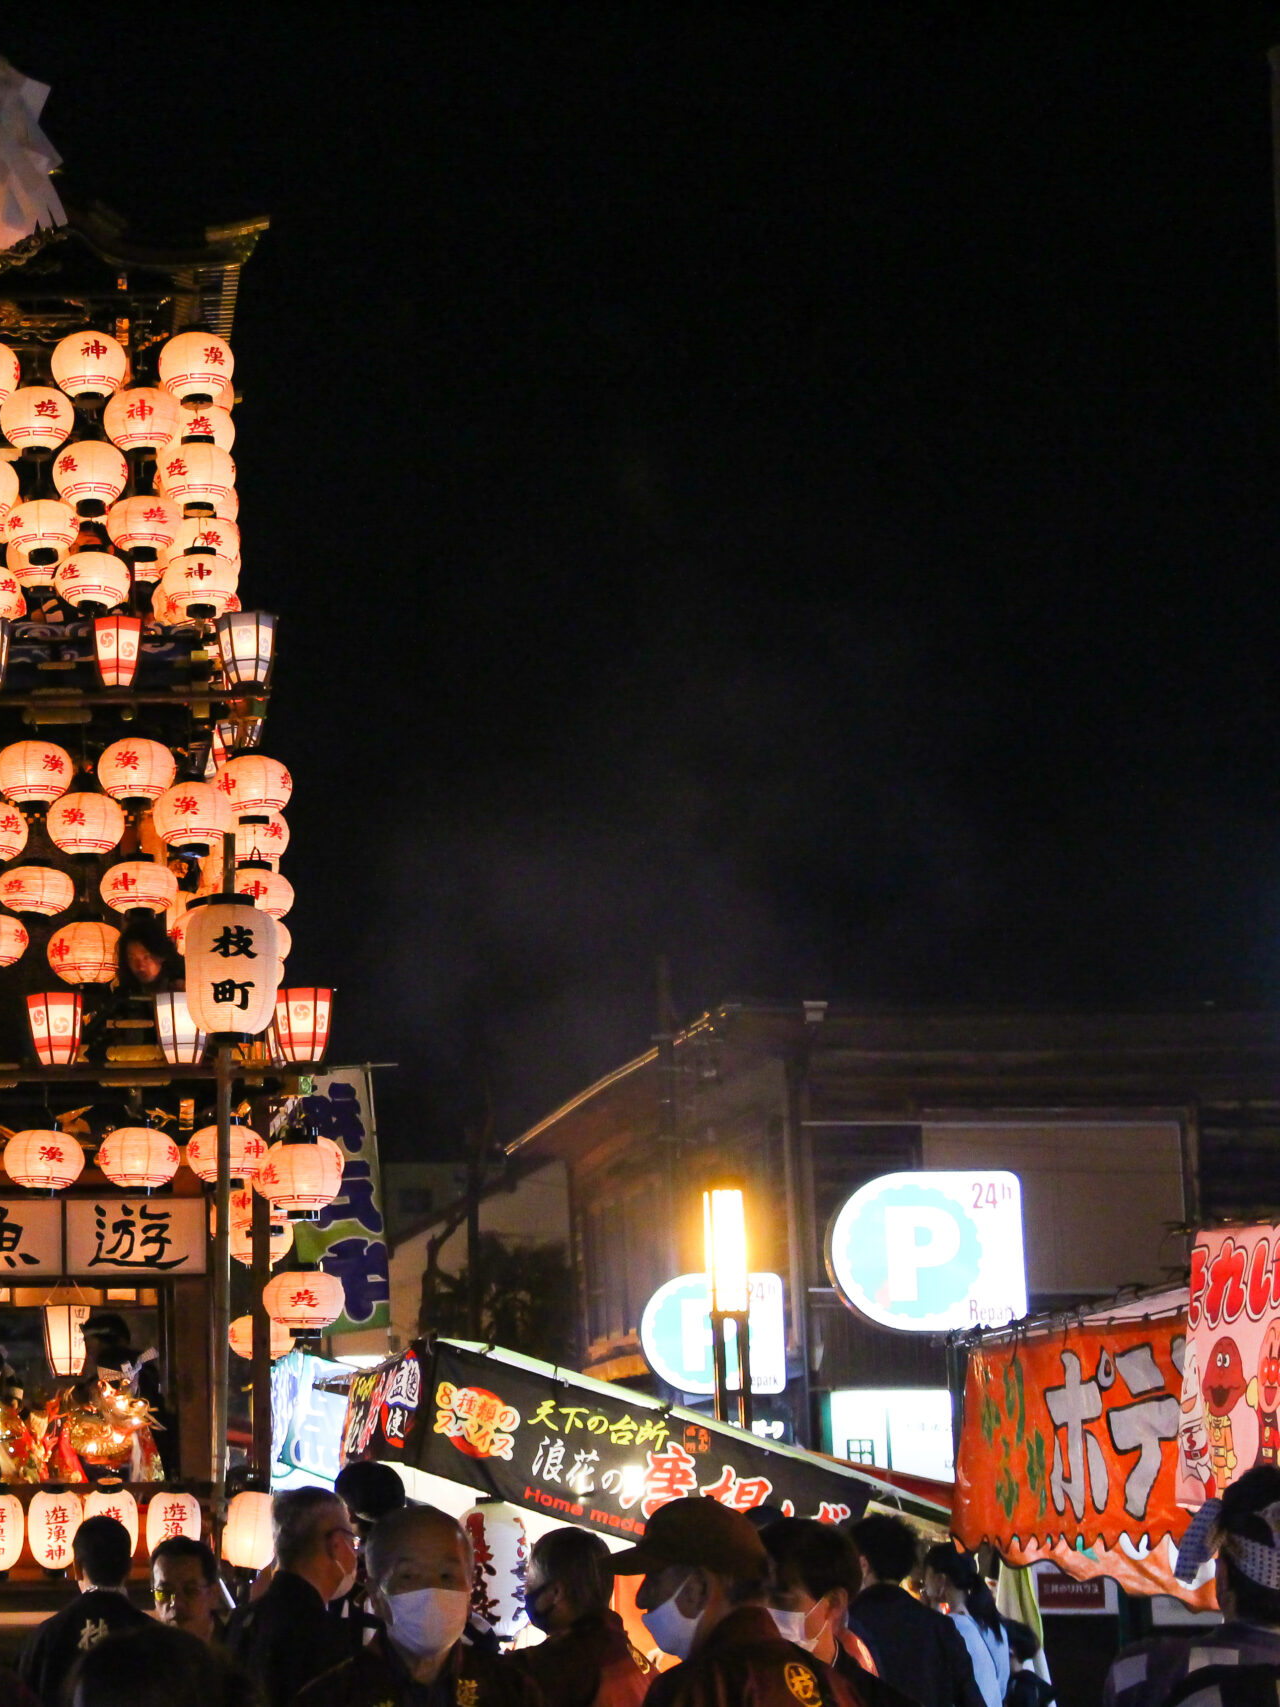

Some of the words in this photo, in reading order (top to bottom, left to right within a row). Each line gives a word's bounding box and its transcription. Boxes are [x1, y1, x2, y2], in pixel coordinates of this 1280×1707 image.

[81, 339, 107, 359] 神
[34, 399, 60, 419] 遊
[127, 399, 153, 420] 神
[184, 563, 212, 580] 神
[0, 812, 23, 834] 遊
[111, 873, 136, 891] 神
[240, 880, 268, 900] 神
[210, 925, 258, 1010] 枝町
[88, 1204, 189, 1270] 遊
[885, 1205, 961, 1302] P
[749, 1374, 779, 1387] epark
[436, 1382, 520, 1432] 8種類の
[527, 1399, 670, 1452] 天下の台所
[1044, 1341, 1190, 1523] ポテ
[523, 1485, 585, 1517] Home
[588, 1508, 647, 1537] made
